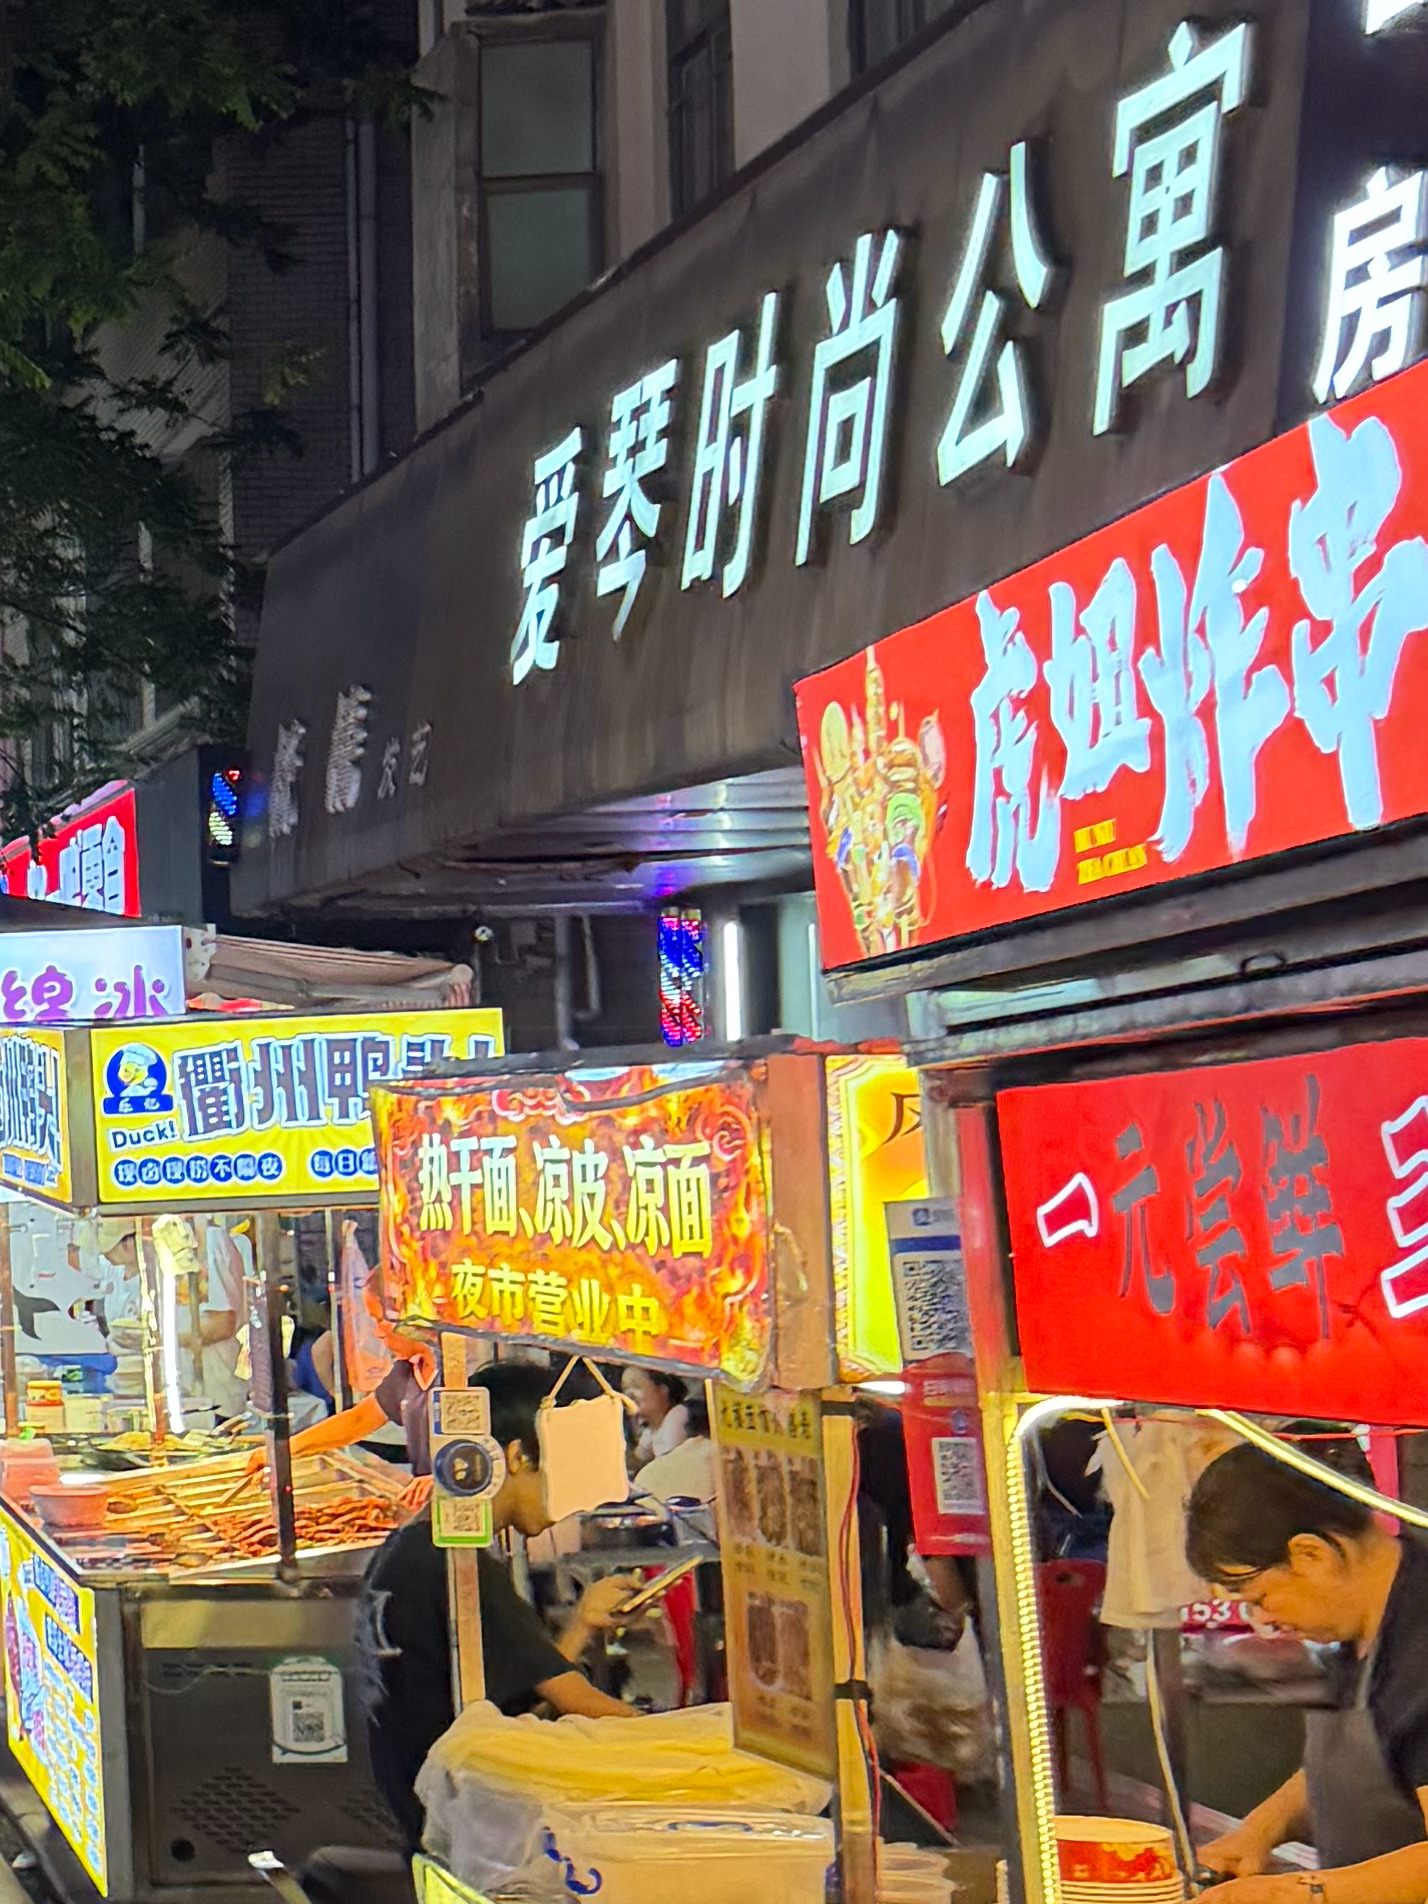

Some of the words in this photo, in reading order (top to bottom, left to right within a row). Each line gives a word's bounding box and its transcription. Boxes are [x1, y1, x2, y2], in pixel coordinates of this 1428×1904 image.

[511, 20, 1252, 686] 爱琴时尚公寓
[965, 410, 1428, 893] 虎姐炸串
[111, 1121, 178, 1150] Duck!
[173, 1031, 496, 1143] 衢州鸭
[417, 1132, 714, 1260] 热干面、凉皮、凉面
[450, 1256, 660, 1345] 夜市营业中
